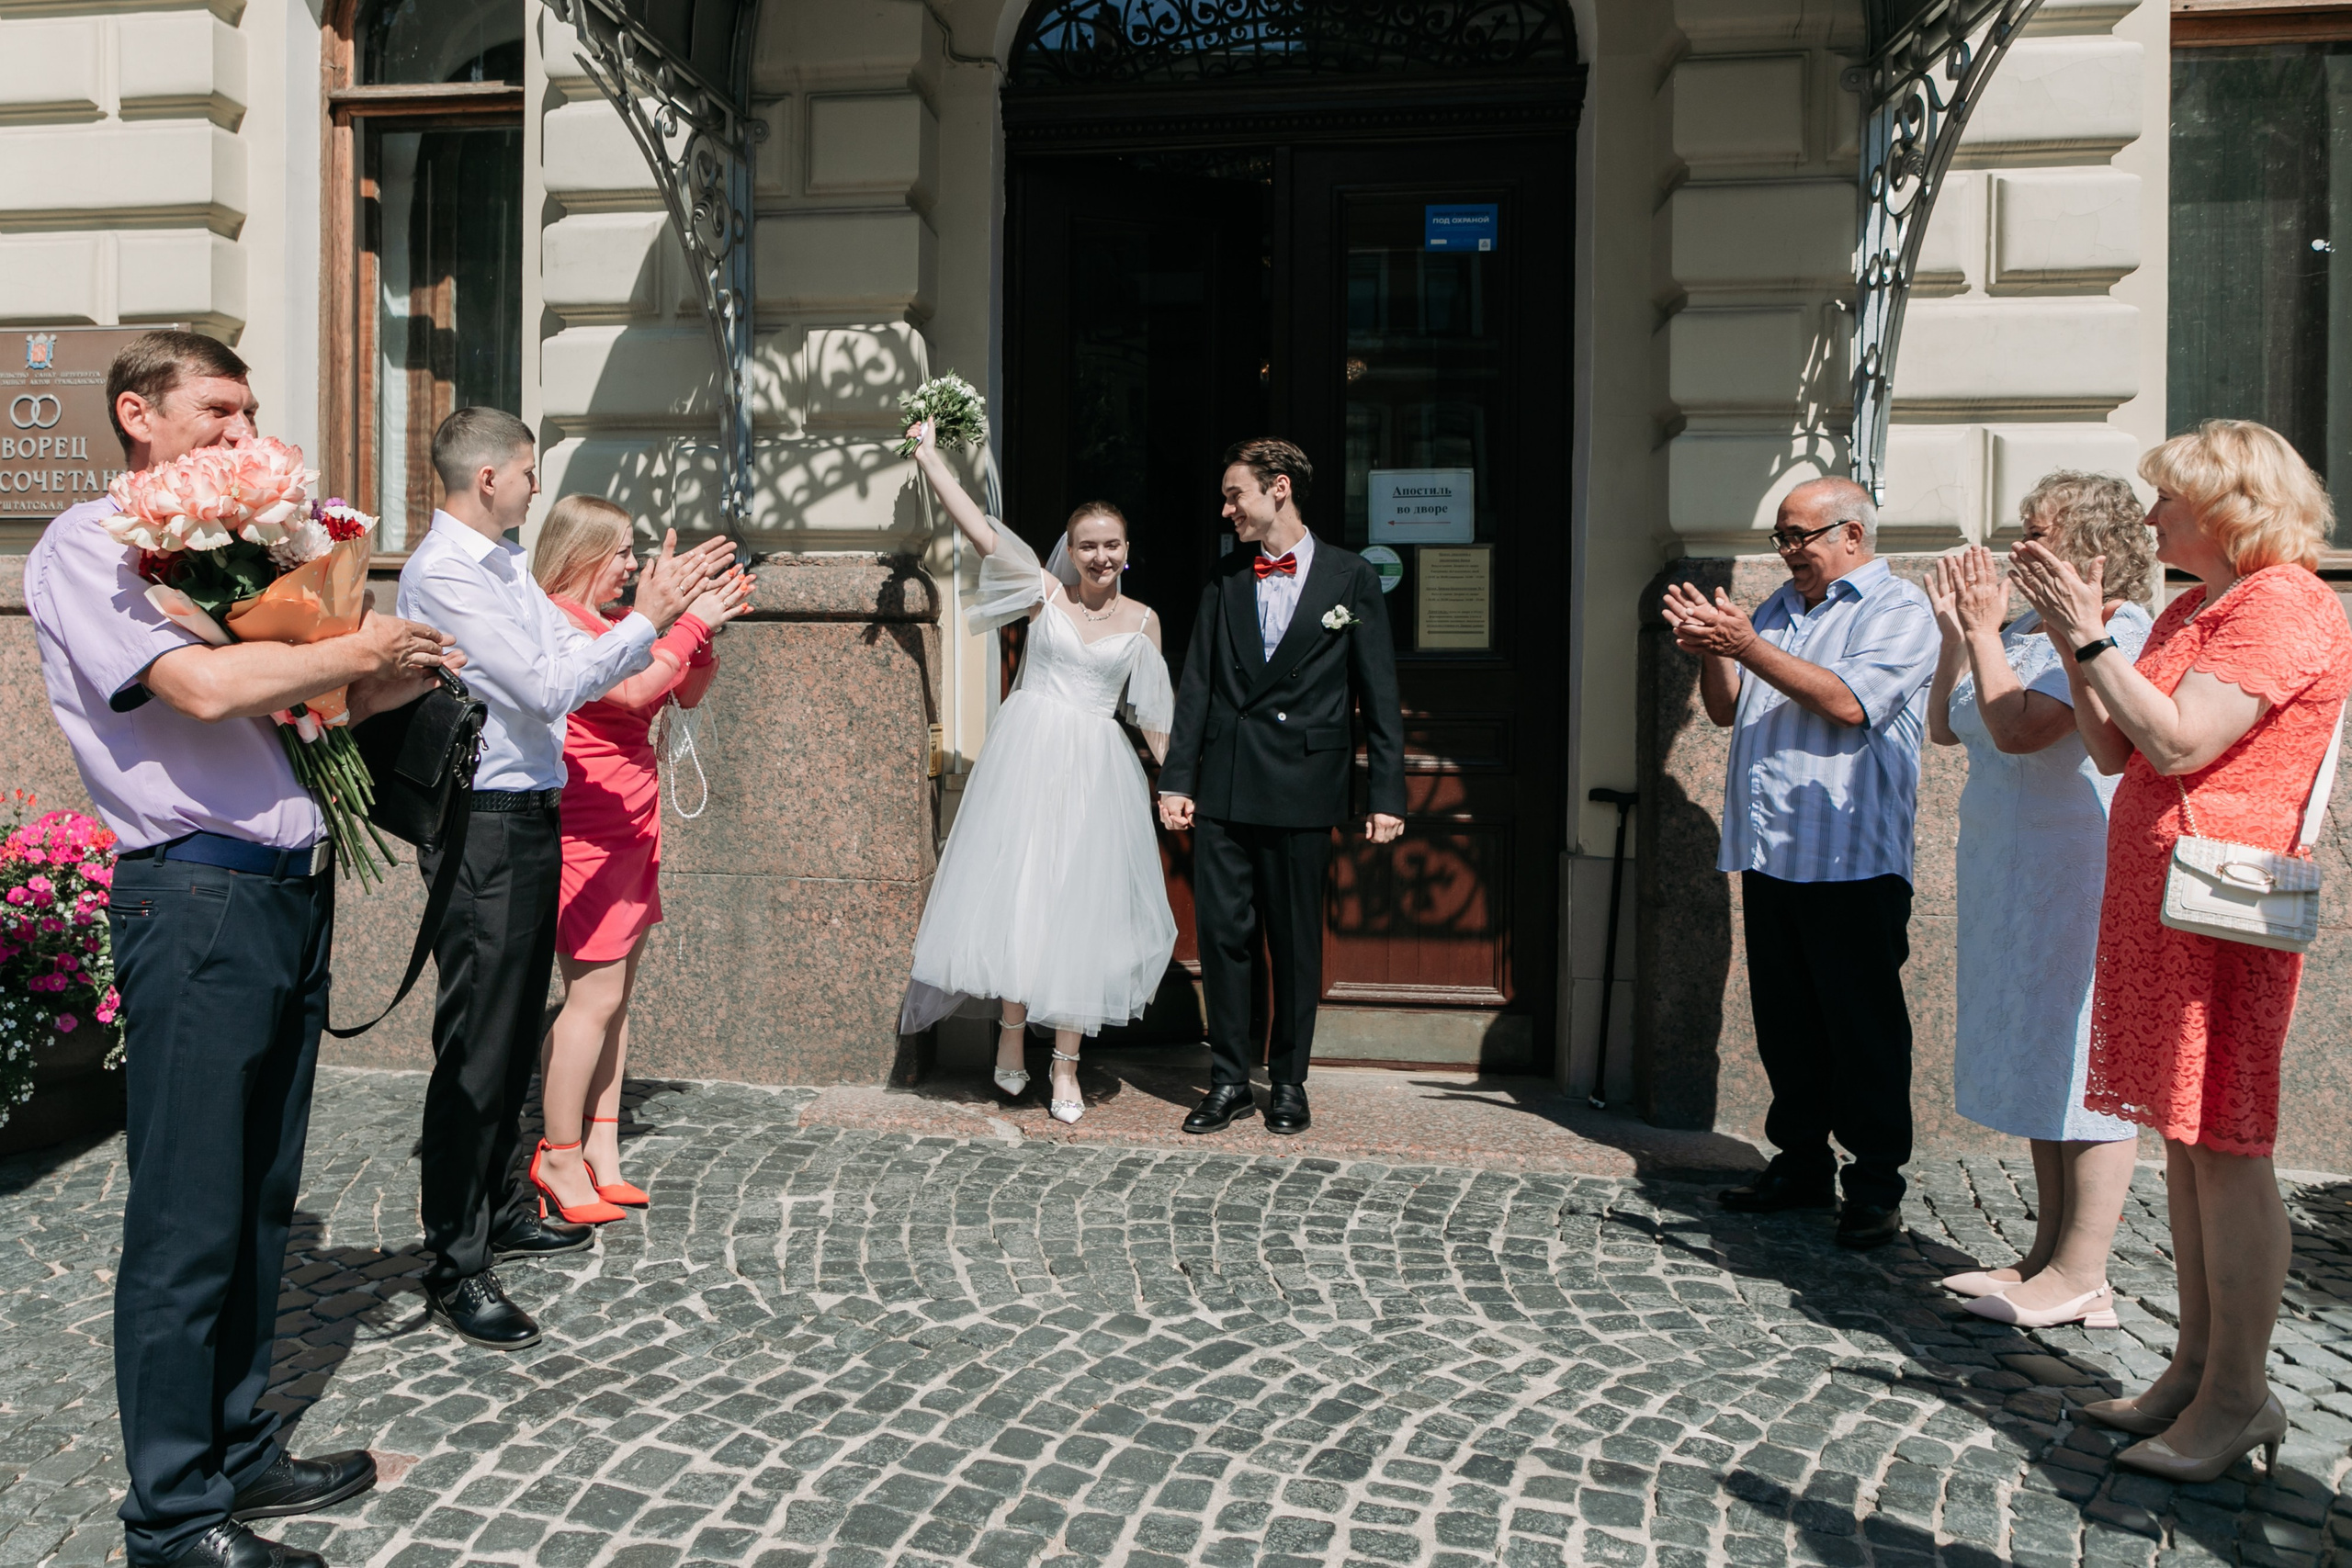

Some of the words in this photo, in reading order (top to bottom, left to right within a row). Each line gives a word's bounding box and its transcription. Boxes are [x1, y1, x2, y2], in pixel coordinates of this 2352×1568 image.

[1452, 216, 1489, 224] ОХРАНОЙ
[2, 436, 88, 461] ВОРЕЦ
[0, 469, 127, 493] СОЧЕТАН
[1393, 486, 1452, 496] Апостиль
[1396, 506, 1410, 514] во
[1413, 505, 1448, 515] дворе
